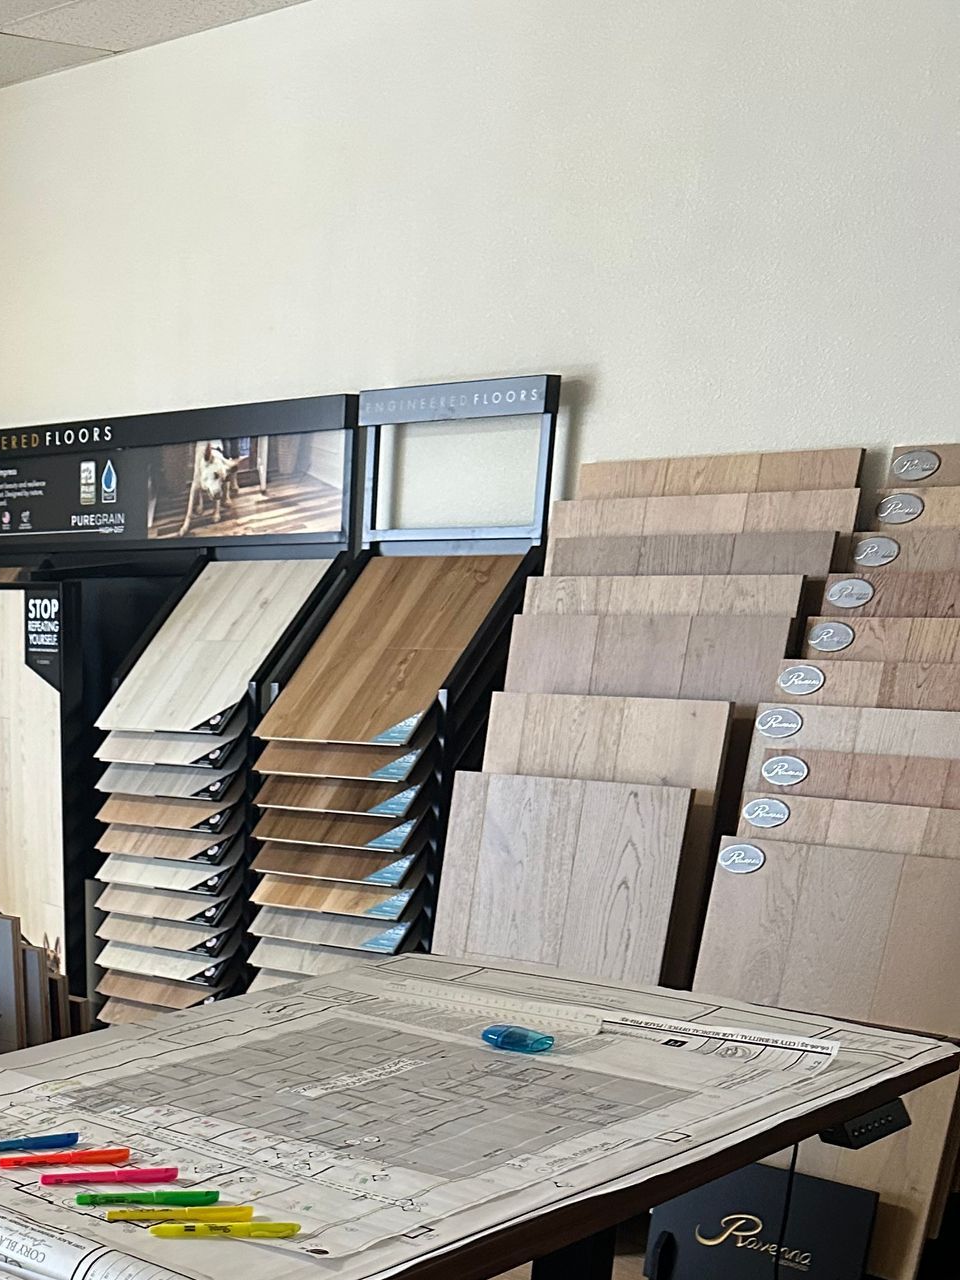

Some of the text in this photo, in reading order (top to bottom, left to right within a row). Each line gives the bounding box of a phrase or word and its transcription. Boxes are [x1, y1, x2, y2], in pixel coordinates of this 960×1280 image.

[366, 389, 538, 414] ENGINEERED FLOORS
[45, 426, 113, 446] FLOORS
[71, 513, 125, 527] PUREGRAIN
[28, 599, 59, 619] STOP
[28, 621, 59, 632] REPEATING
[17, 1245, 46, 1263] CORY
